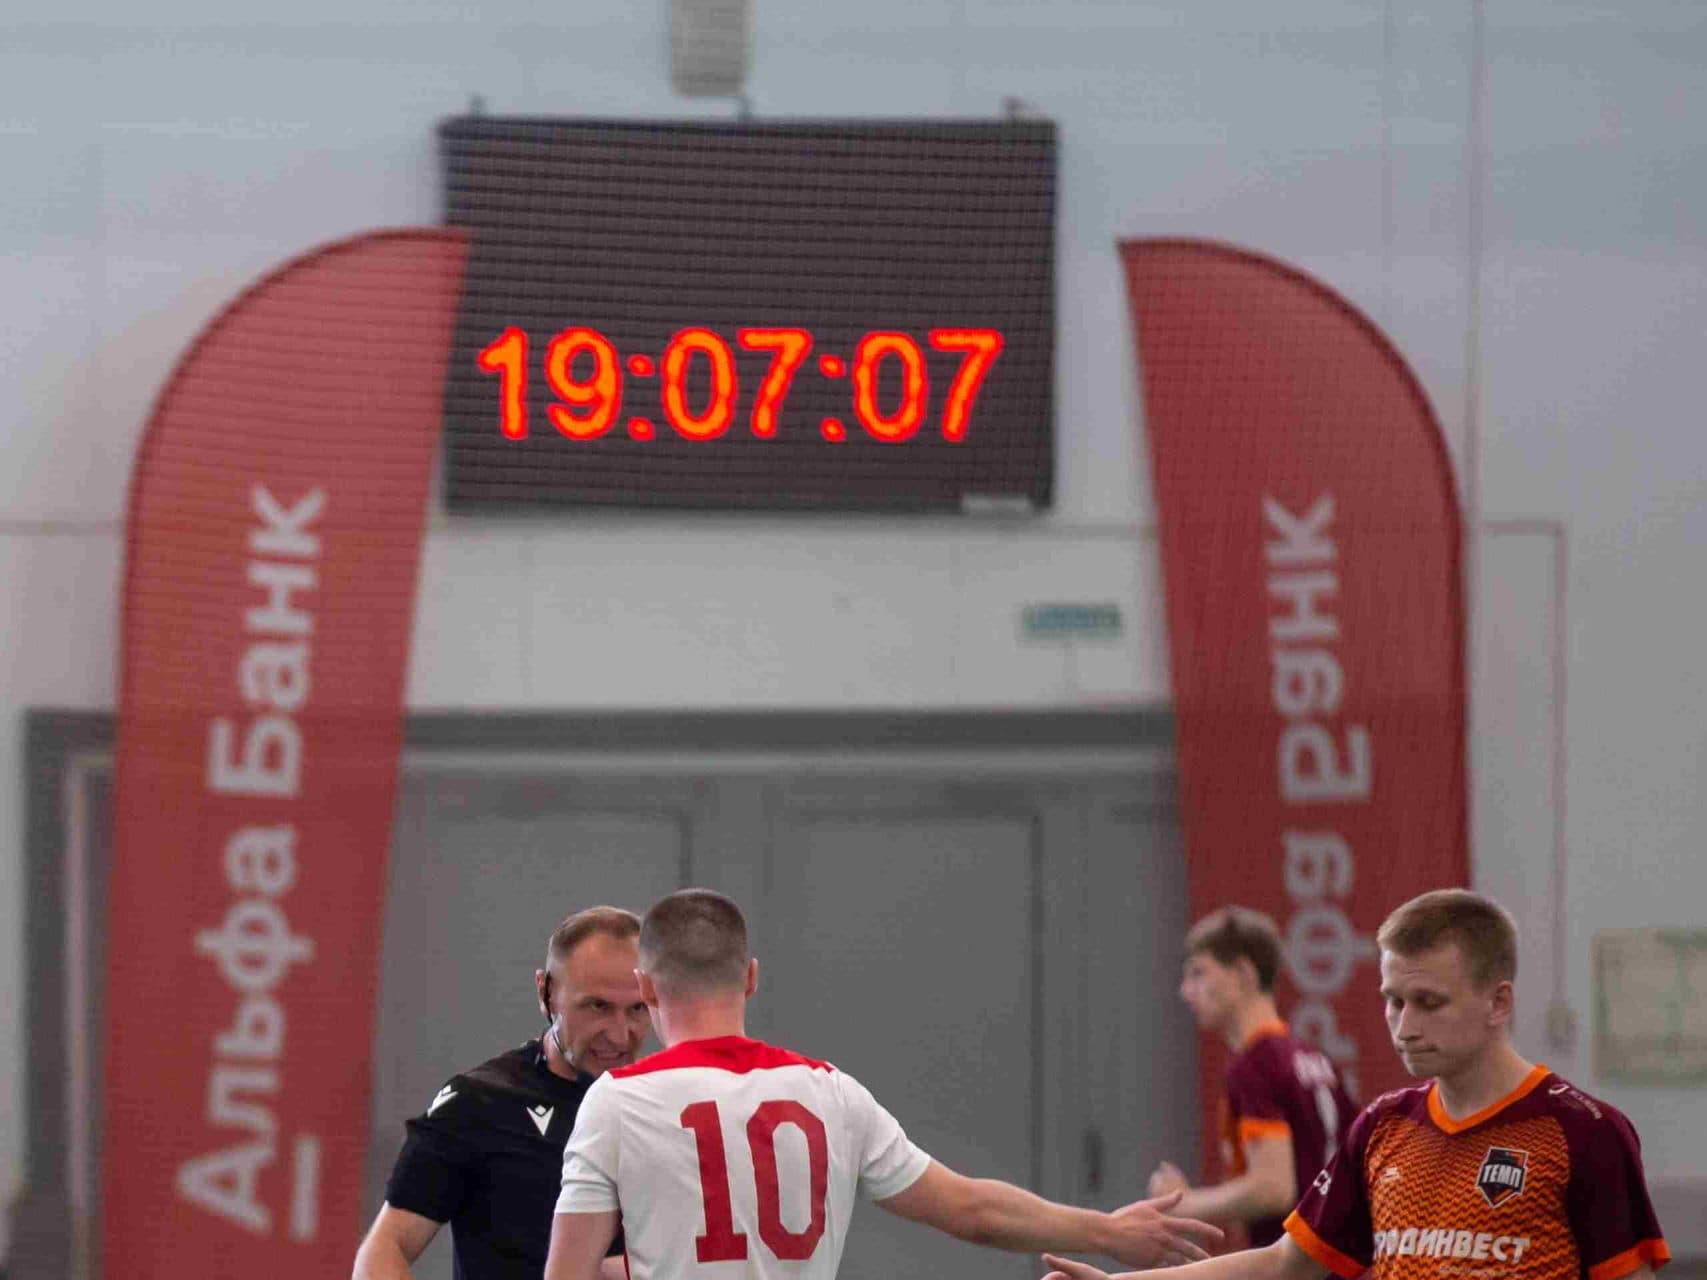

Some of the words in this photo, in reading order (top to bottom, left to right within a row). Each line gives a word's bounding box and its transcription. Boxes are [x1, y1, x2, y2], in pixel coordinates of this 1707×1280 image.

[477, 326, 1004, 442] 19:07:07
[207, 484, 330, 798] Банк
[175, 822, 316, 1234] Альфа
[679, 1099, 829, 1263] 10
[1481, 1163, 1523, 1188] ТЕМП
